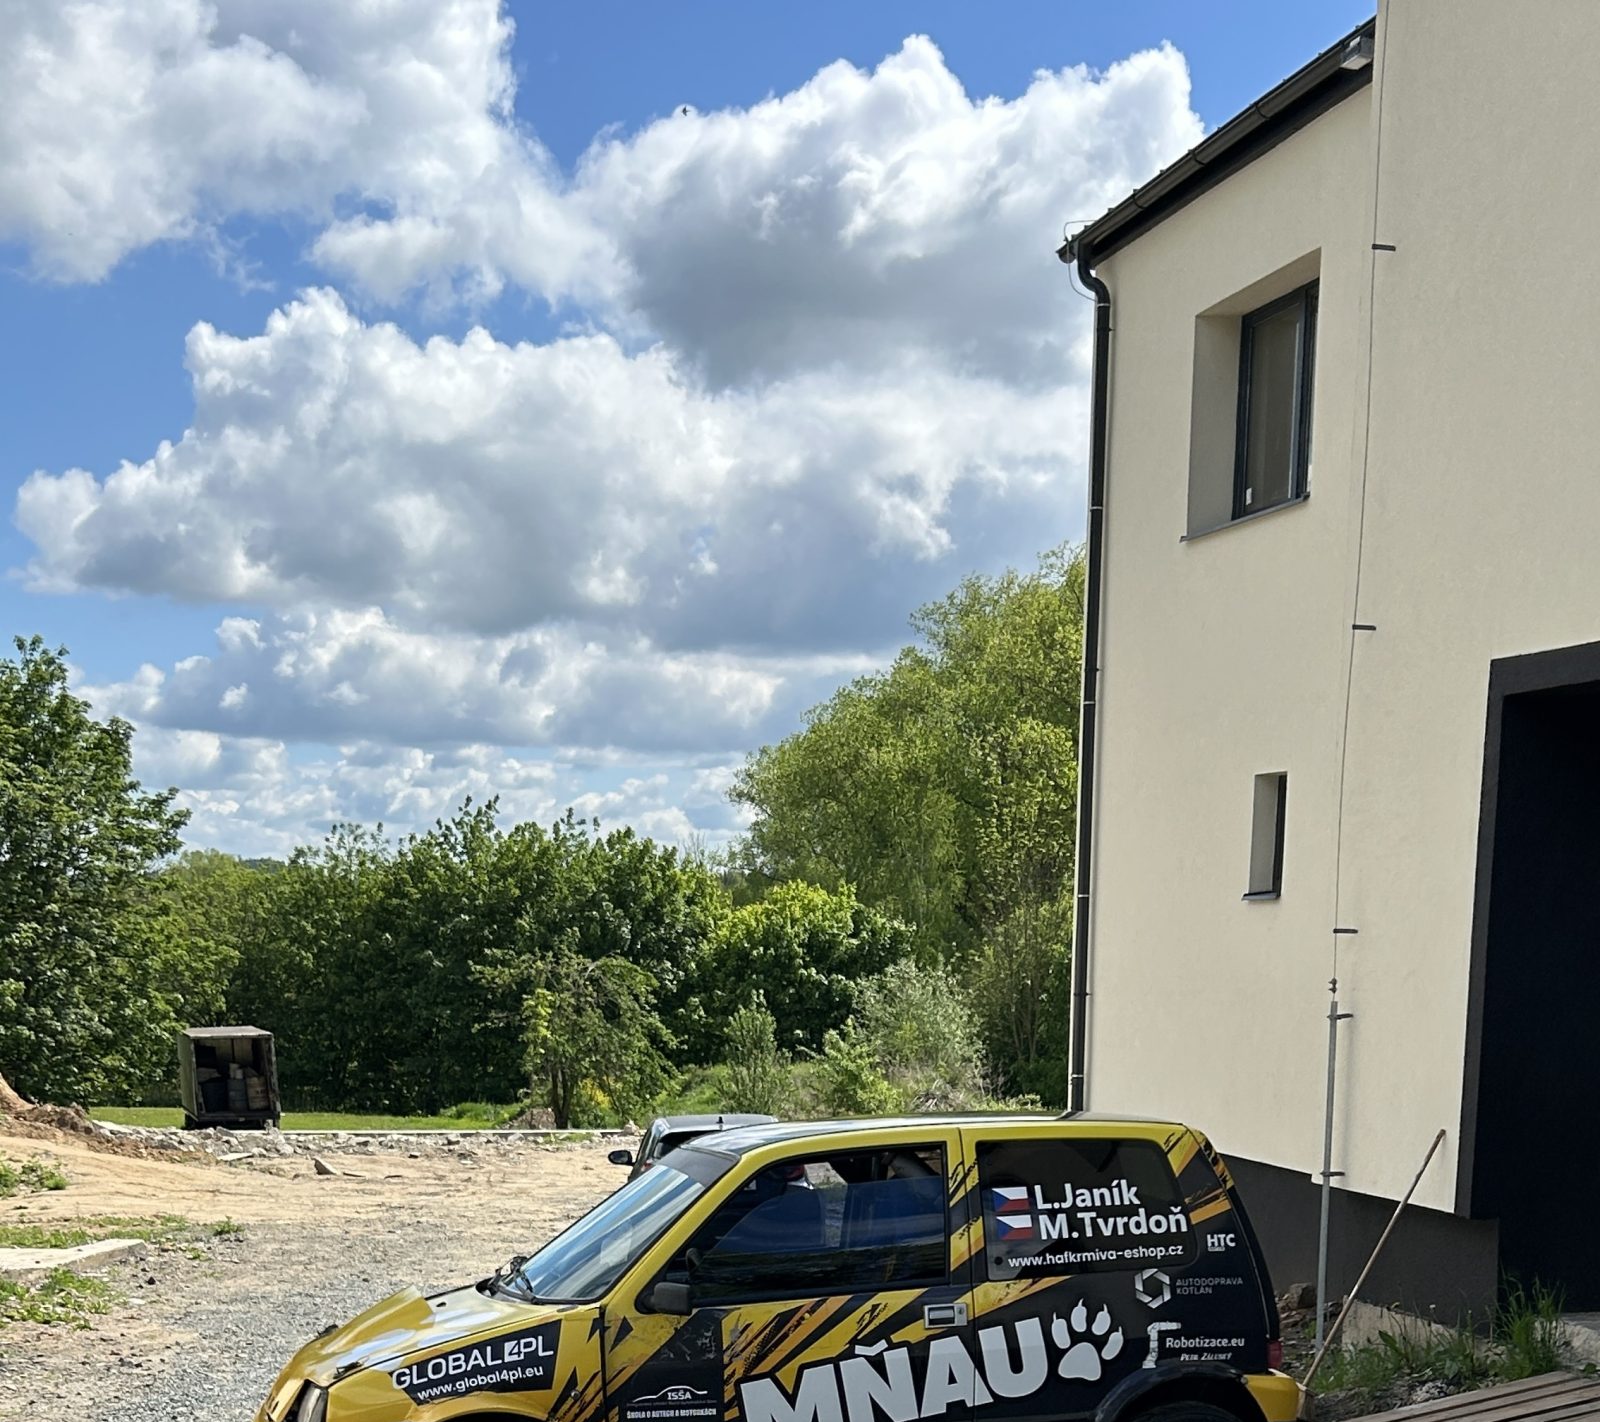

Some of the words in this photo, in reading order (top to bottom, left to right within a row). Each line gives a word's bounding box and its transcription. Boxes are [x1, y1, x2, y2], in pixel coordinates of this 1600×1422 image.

[1034, 1178, 1141, 1209] L.Janík
[1038, 1206, 1188, 1240] M.Tvrdoň
[1206, 1233, 1236, 1247] HTC
[1008, 1245, 1184, 1268] www.hafkrmiva-eshop.cz
[1176, 1277, 1243, 1287] AUTODOPRAVA
[1165, 1336, 1245, 1348] Robotizace.eu
[392, 1336, 554, 1390] GLOBAL4PL
[417, 1366, 544, 1401] www.global4pl.eu
